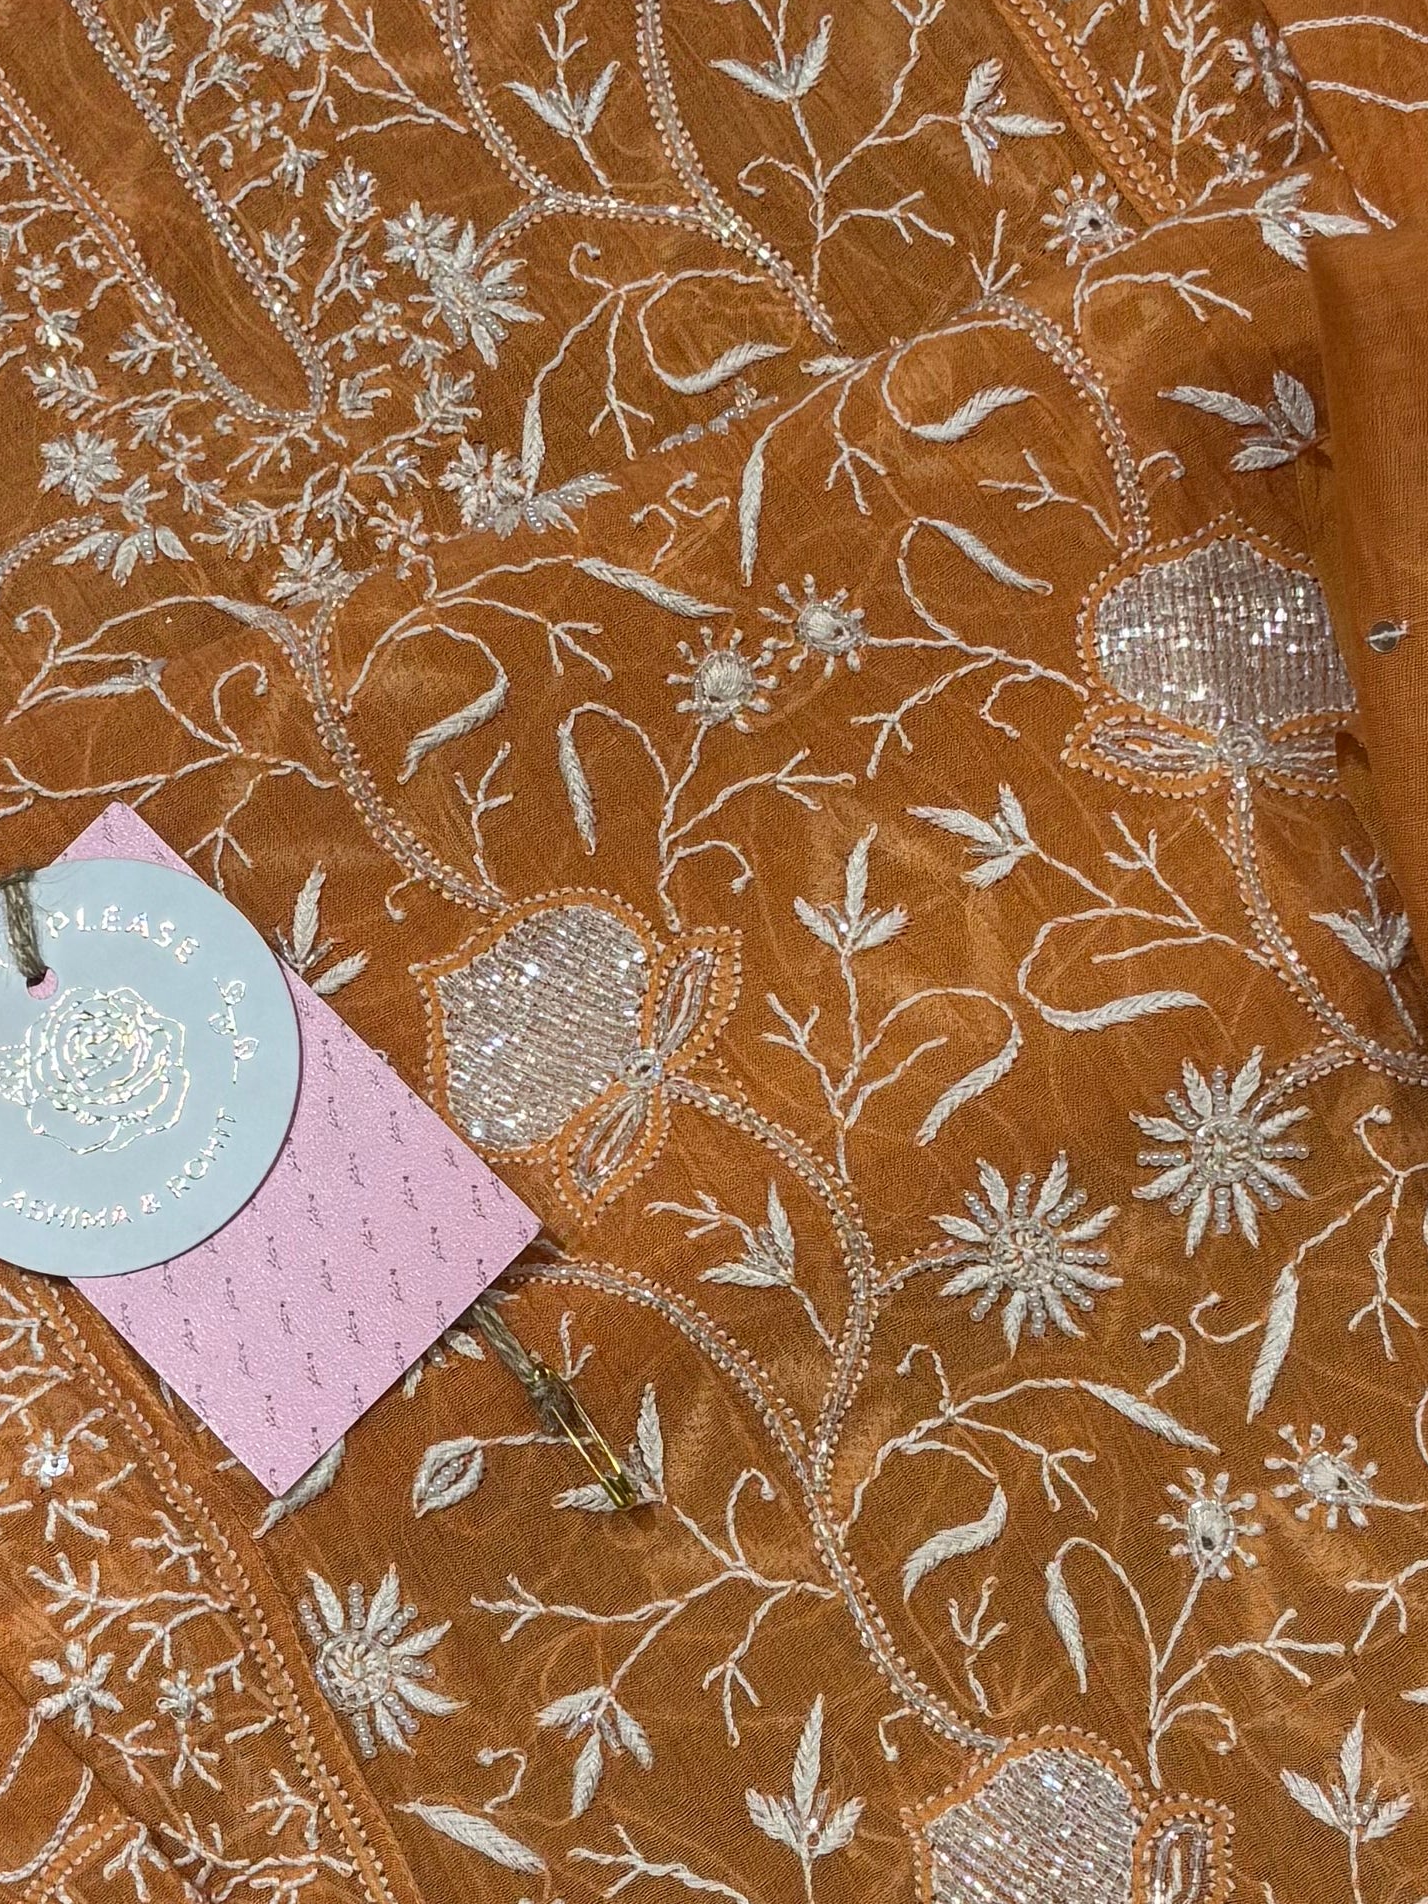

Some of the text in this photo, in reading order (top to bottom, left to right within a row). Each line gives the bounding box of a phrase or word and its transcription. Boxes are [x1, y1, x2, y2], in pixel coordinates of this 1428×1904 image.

[46, 904, 199, 964] PLEASE
[2, 1107, 237, 1229] ASHIMA & ROHIT
